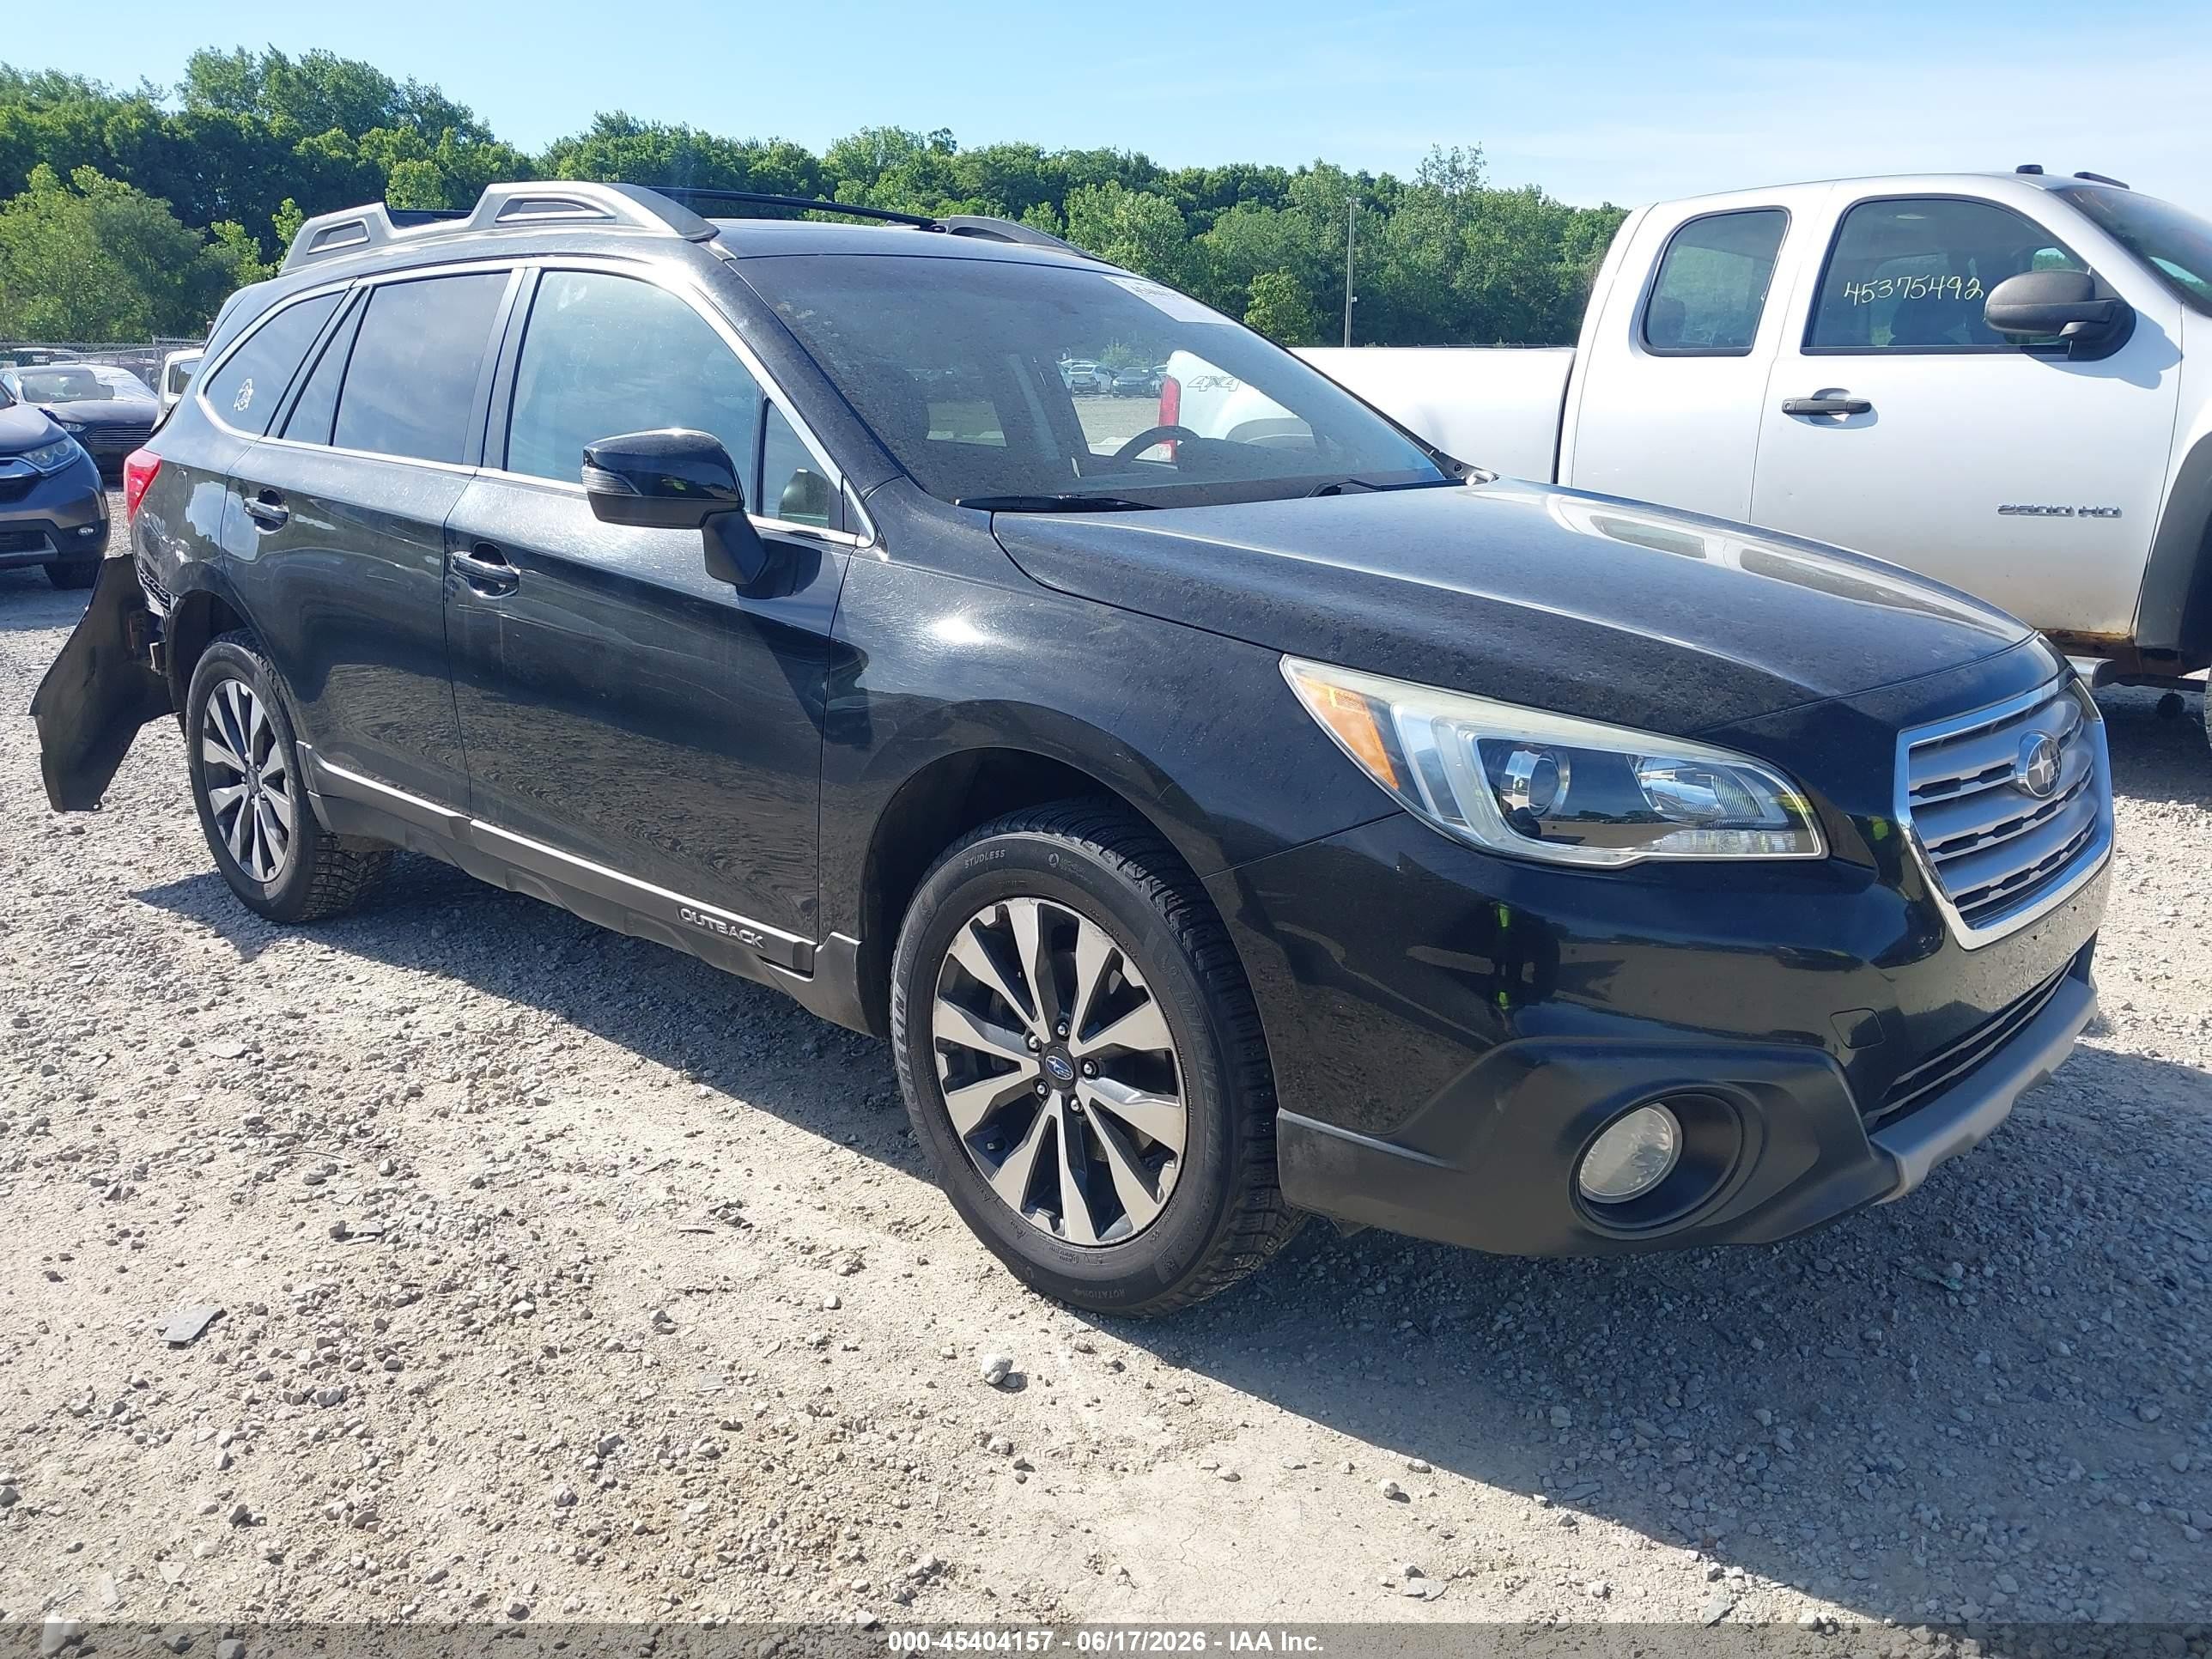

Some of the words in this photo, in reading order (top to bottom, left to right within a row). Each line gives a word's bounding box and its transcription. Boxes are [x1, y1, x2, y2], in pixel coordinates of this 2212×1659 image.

[1844, 275, 1984, 306] 45375492
[1997, 503, 2075, 518] 2500
[2077, 505, 2123, 519] HD
[964, 848, 1006, 870] STUDLESS
[680, 908, 764, 949] OUTBACK
